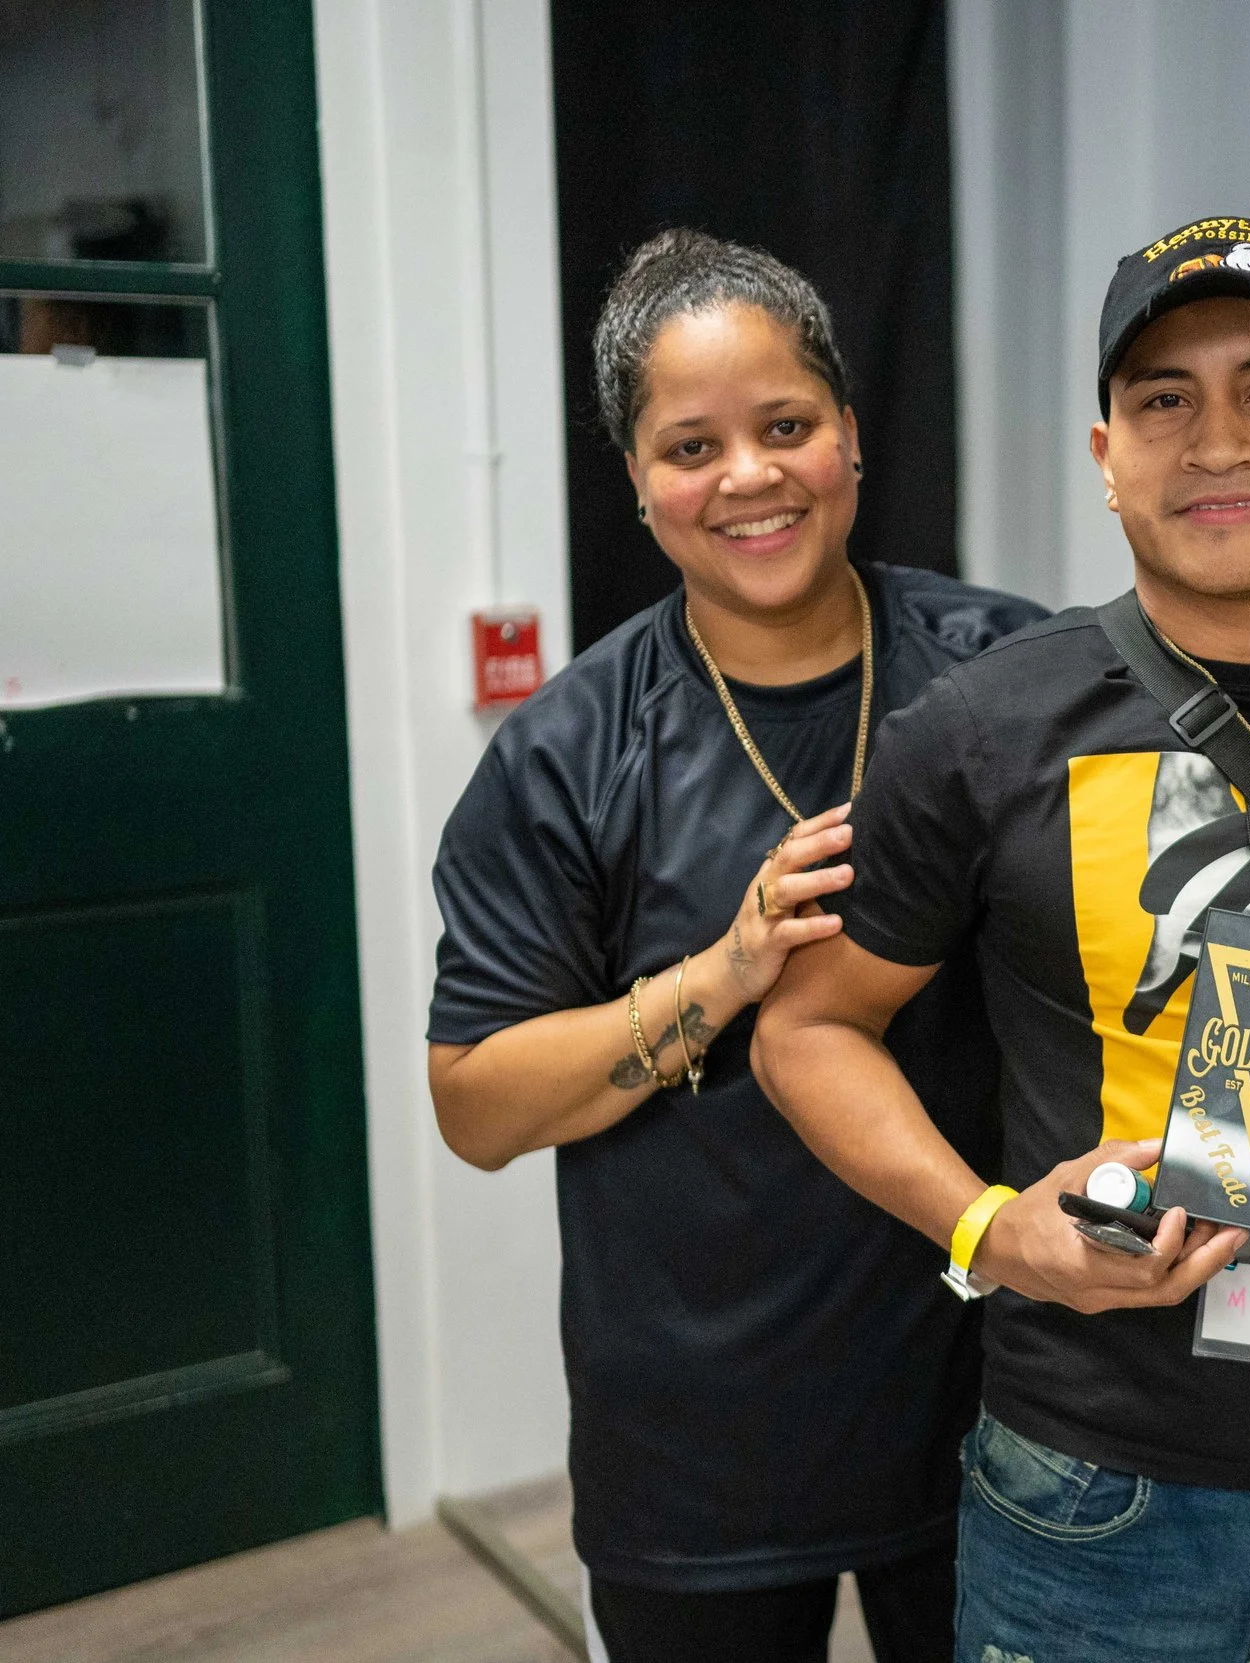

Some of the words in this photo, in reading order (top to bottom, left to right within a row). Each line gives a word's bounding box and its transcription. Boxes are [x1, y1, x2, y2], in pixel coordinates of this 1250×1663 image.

[1225, 1079, 1242, 1091] EST
[1180, 1085, 1218, 1143] Best
[1208, 1143, 1248, 1209] Fade
